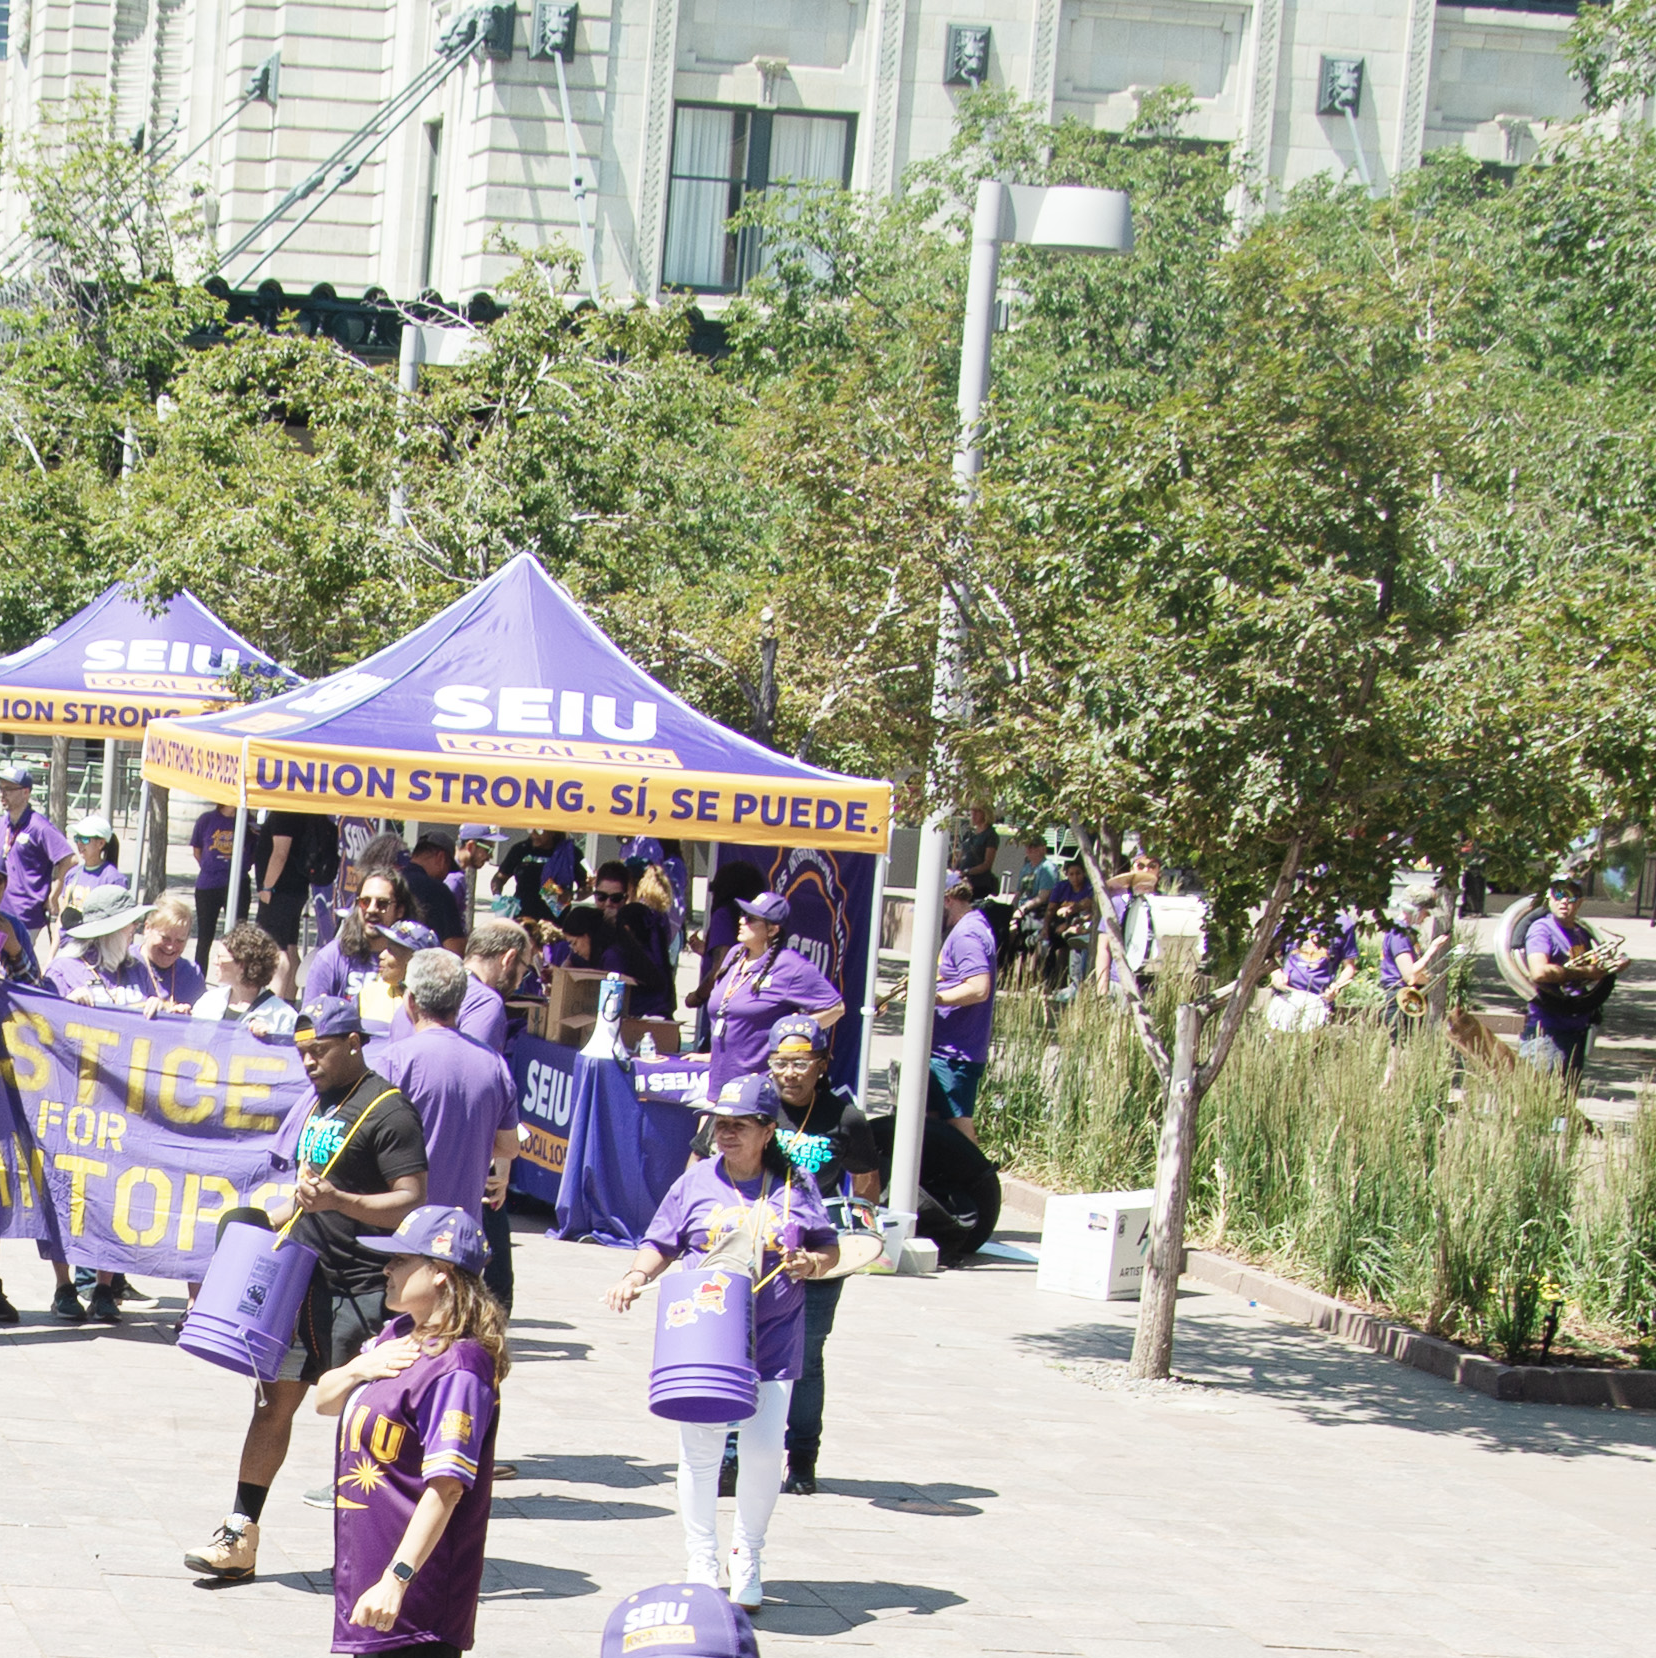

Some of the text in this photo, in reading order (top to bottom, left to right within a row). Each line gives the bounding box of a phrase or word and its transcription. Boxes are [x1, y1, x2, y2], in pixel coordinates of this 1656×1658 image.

[82, 639, 240, 676] SEIU
[90, 676, 233, 693] LOCAL 10
[431, 684, 658, 741] SEIU
[447, 738, 671, 765] LOCAL 105
[257, 758, 879, 834] UNION STRONG. SÍ, SE PUEDE.
[522, 1059, 574, 1127] SEIU
[37, 1100, 127, 1151] FOR
[549, 1143, 568, 1165] 10
[623, 1601, 689, 1633] SEIU
